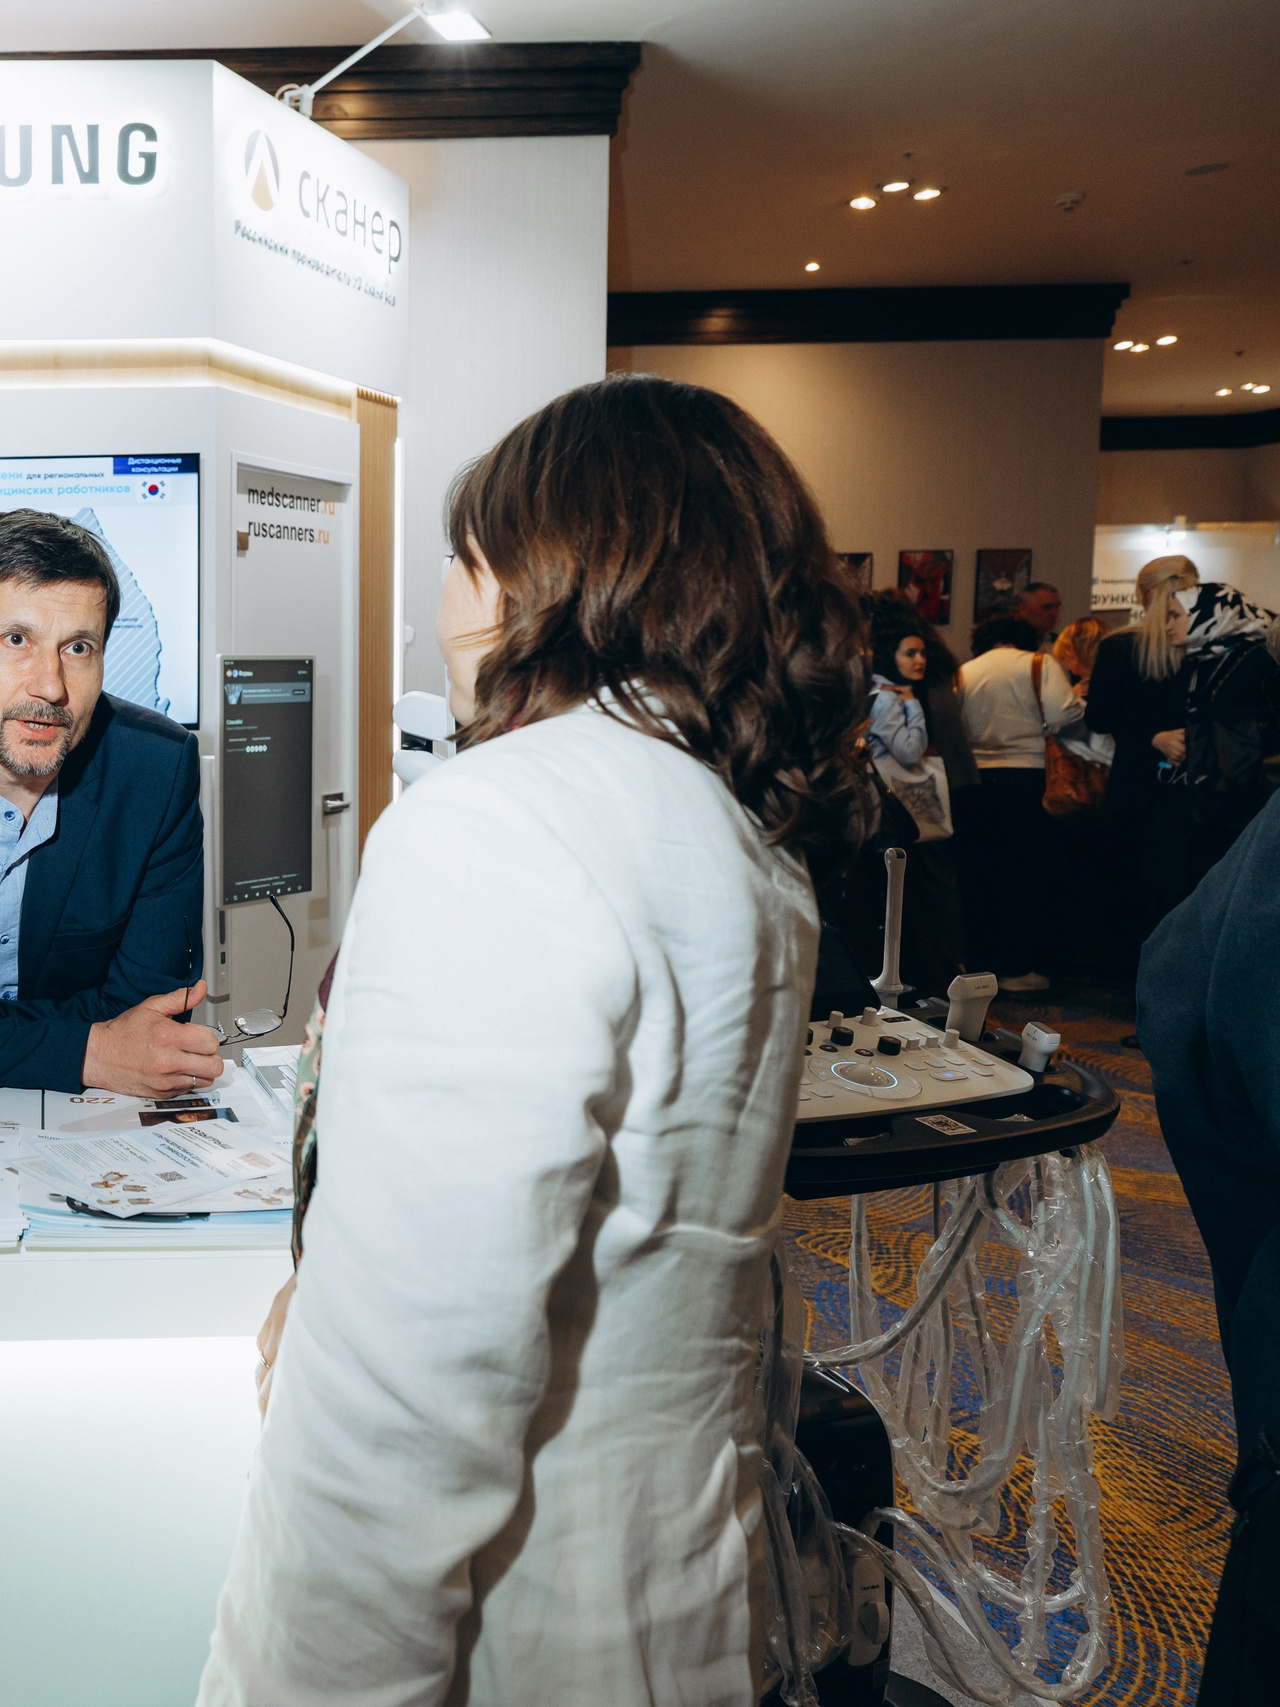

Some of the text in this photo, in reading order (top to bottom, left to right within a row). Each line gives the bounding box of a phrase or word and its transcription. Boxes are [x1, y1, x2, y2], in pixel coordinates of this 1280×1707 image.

[298, 170, 402, 274] сканер
[43, 471, 105, 480] региональных
[56, 484, 131, 496] работников
[247, 486, 335, 515] medscanner.ru
[248, 521, 330, 544] ruscanners.ru
